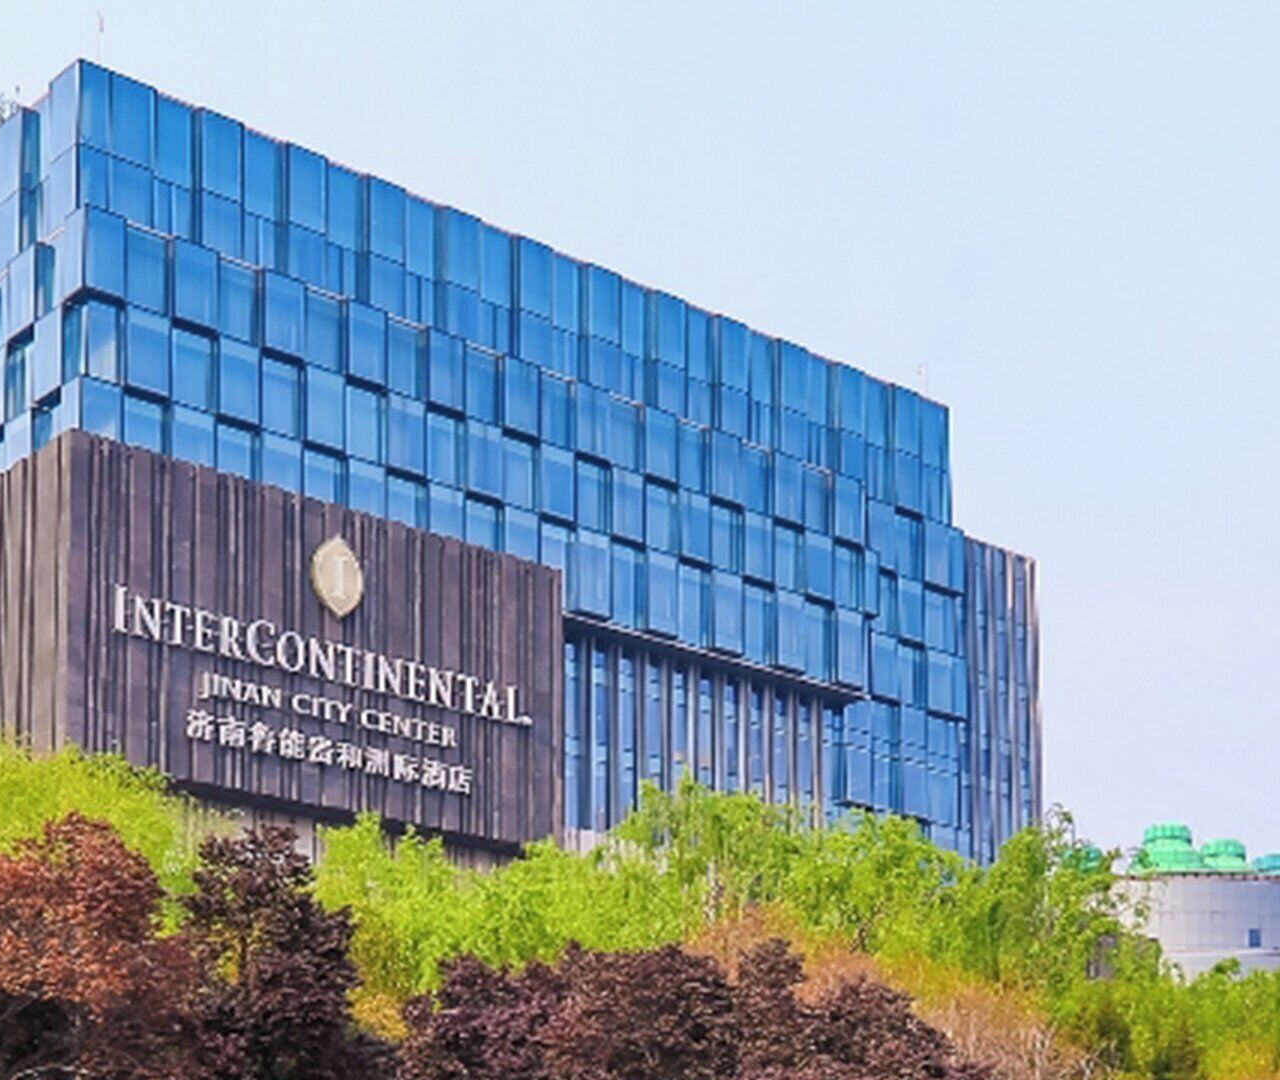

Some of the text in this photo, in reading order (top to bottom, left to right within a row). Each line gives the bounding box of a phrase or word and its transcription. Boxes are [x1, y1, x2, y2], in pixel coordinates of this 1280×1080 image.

[198, 670, 458, 748] JINAN CITY CENTER
